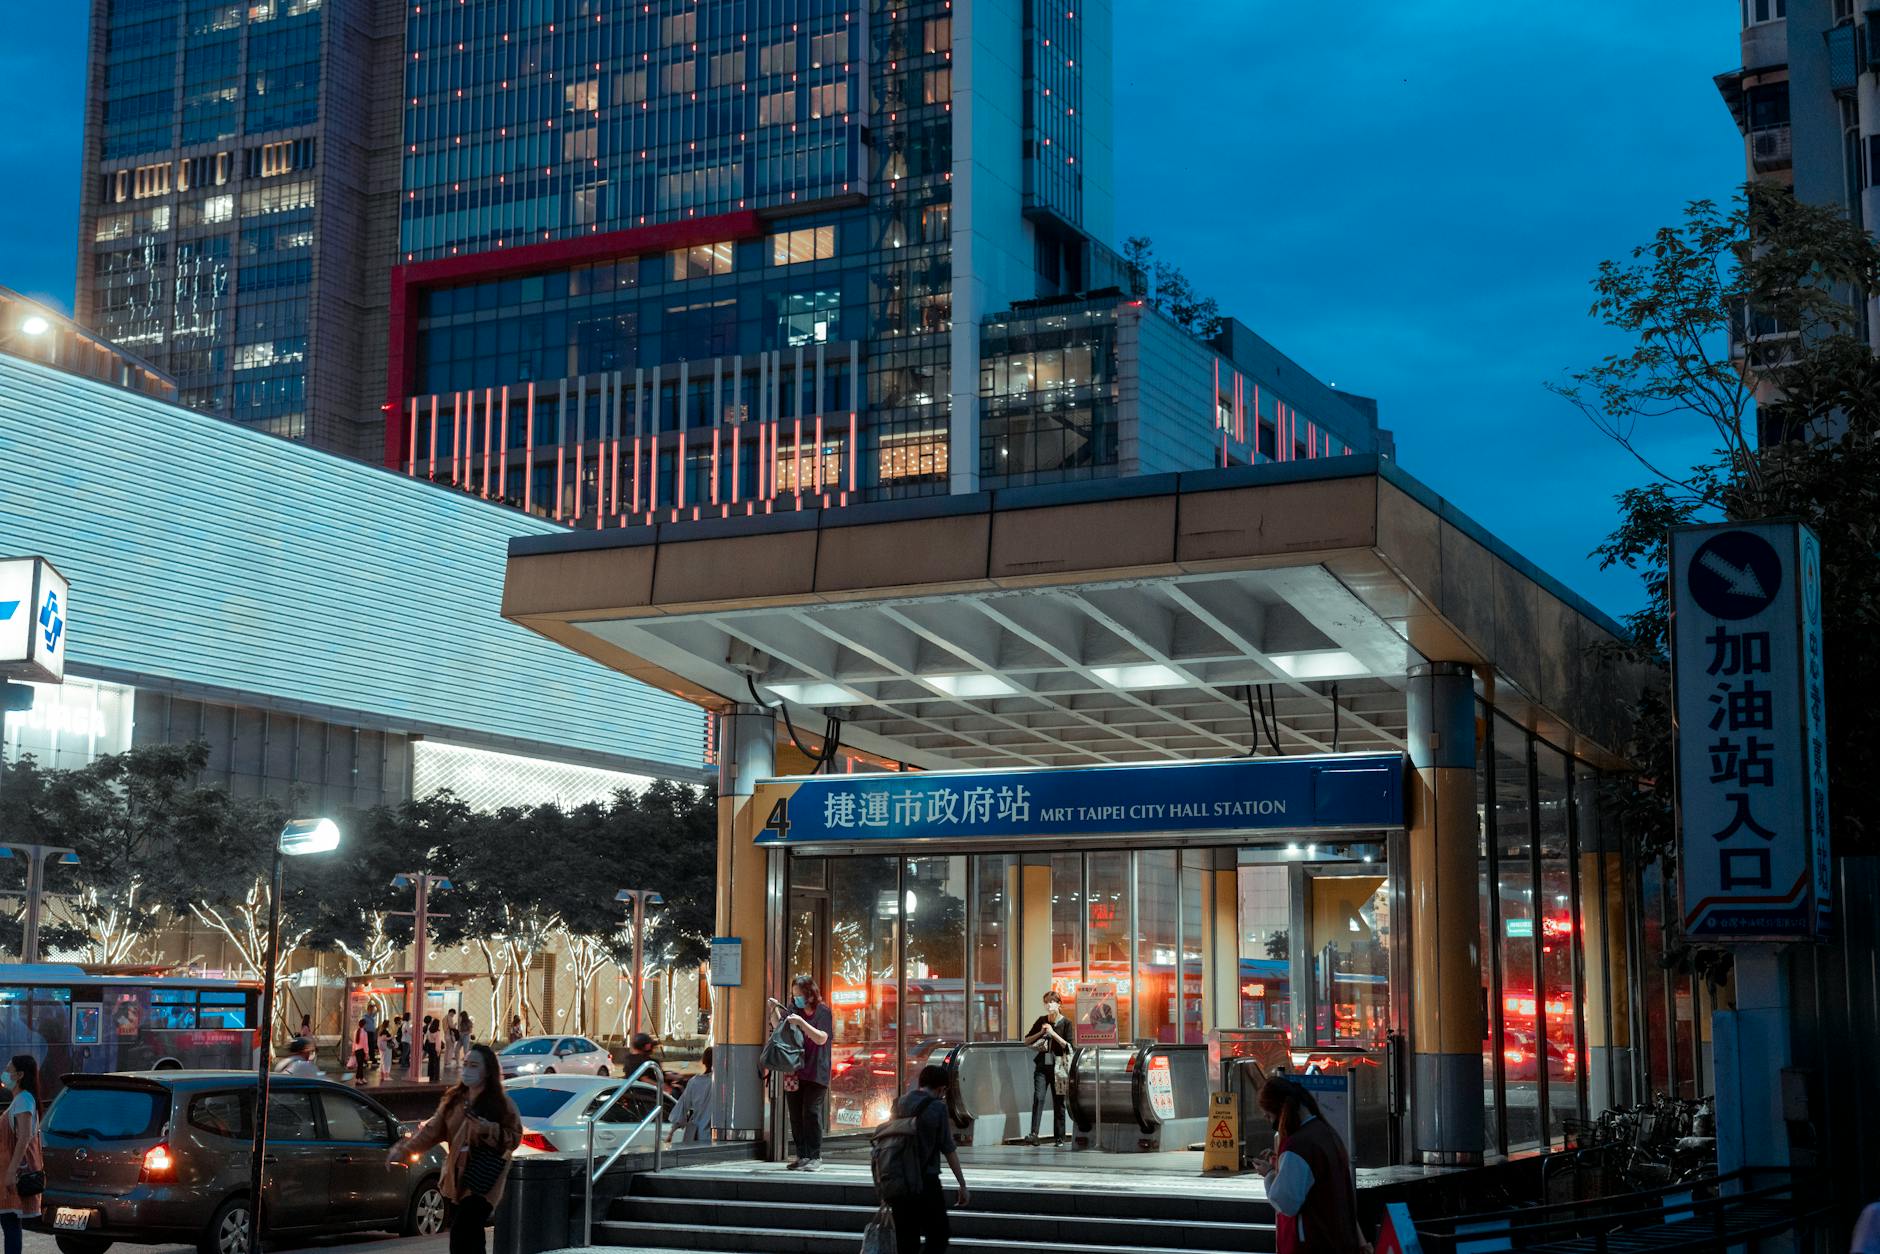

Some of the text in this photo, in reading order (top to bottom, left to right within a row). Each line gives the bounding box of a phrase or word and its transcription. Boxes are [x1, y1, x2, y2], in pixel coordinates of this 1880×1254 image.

[1705, 626, 1777, 890] 加油站入口
[765, 797, 792, 839] 4
[823, 784, 1032, 829] 捷運市政府站
[1040, 799, 1287, 822] MRT TAIPEI CITY HALL STATION
